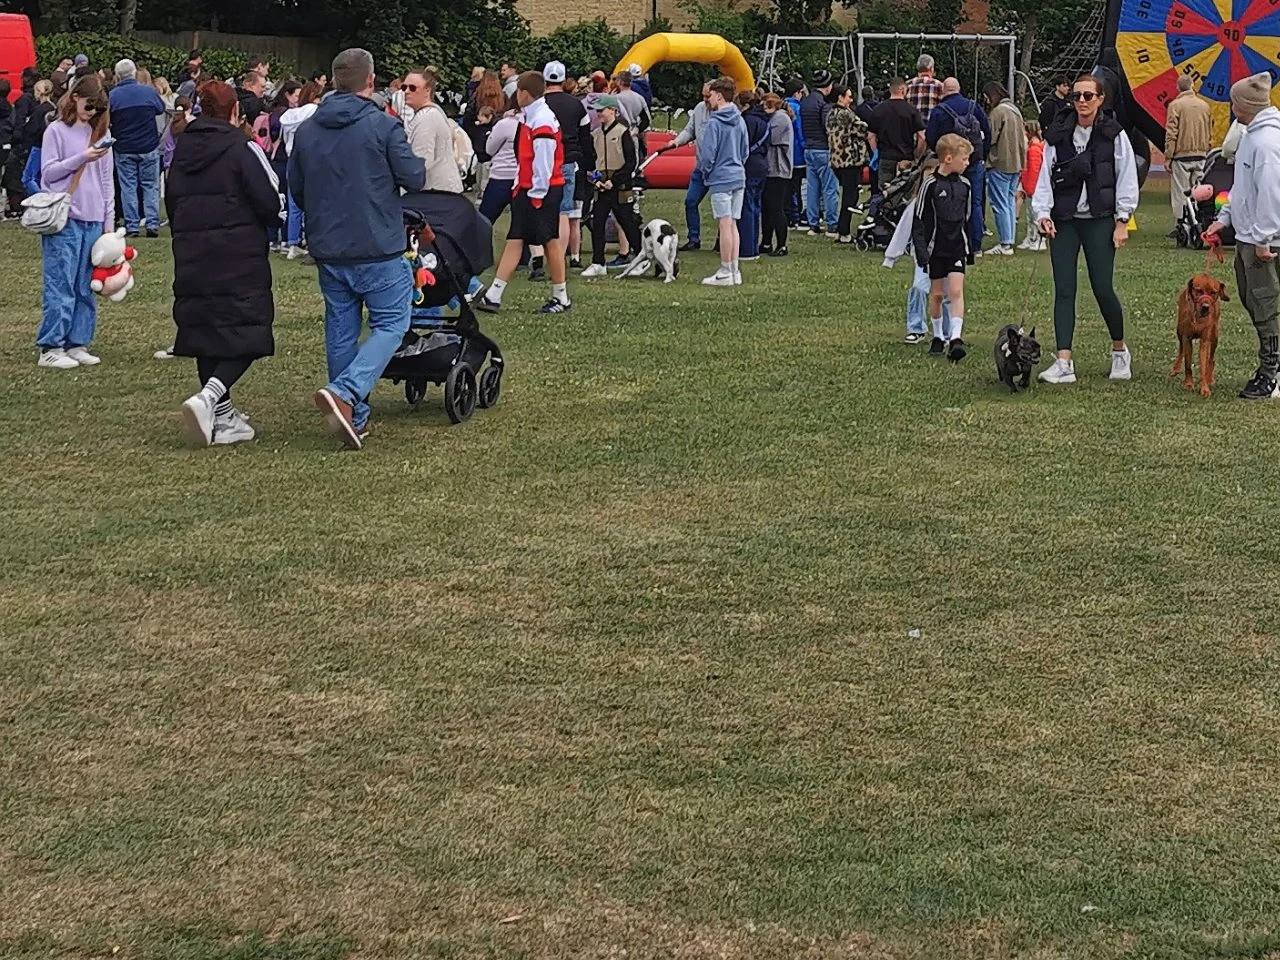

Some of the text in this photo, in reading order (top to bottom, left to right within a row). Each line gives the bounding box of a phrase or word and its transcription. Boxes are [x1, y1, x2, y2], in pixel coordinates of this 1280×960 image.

[1136, 0, 1152, 19] 30
[1171, 10, 1186, 28] 60
[1223, 28, 1240, 42] 90
[1136, 48, 1150, 64] 10
[1172, 38, 1186, 57] 40
[1207, 82, 1225, 97] 40
